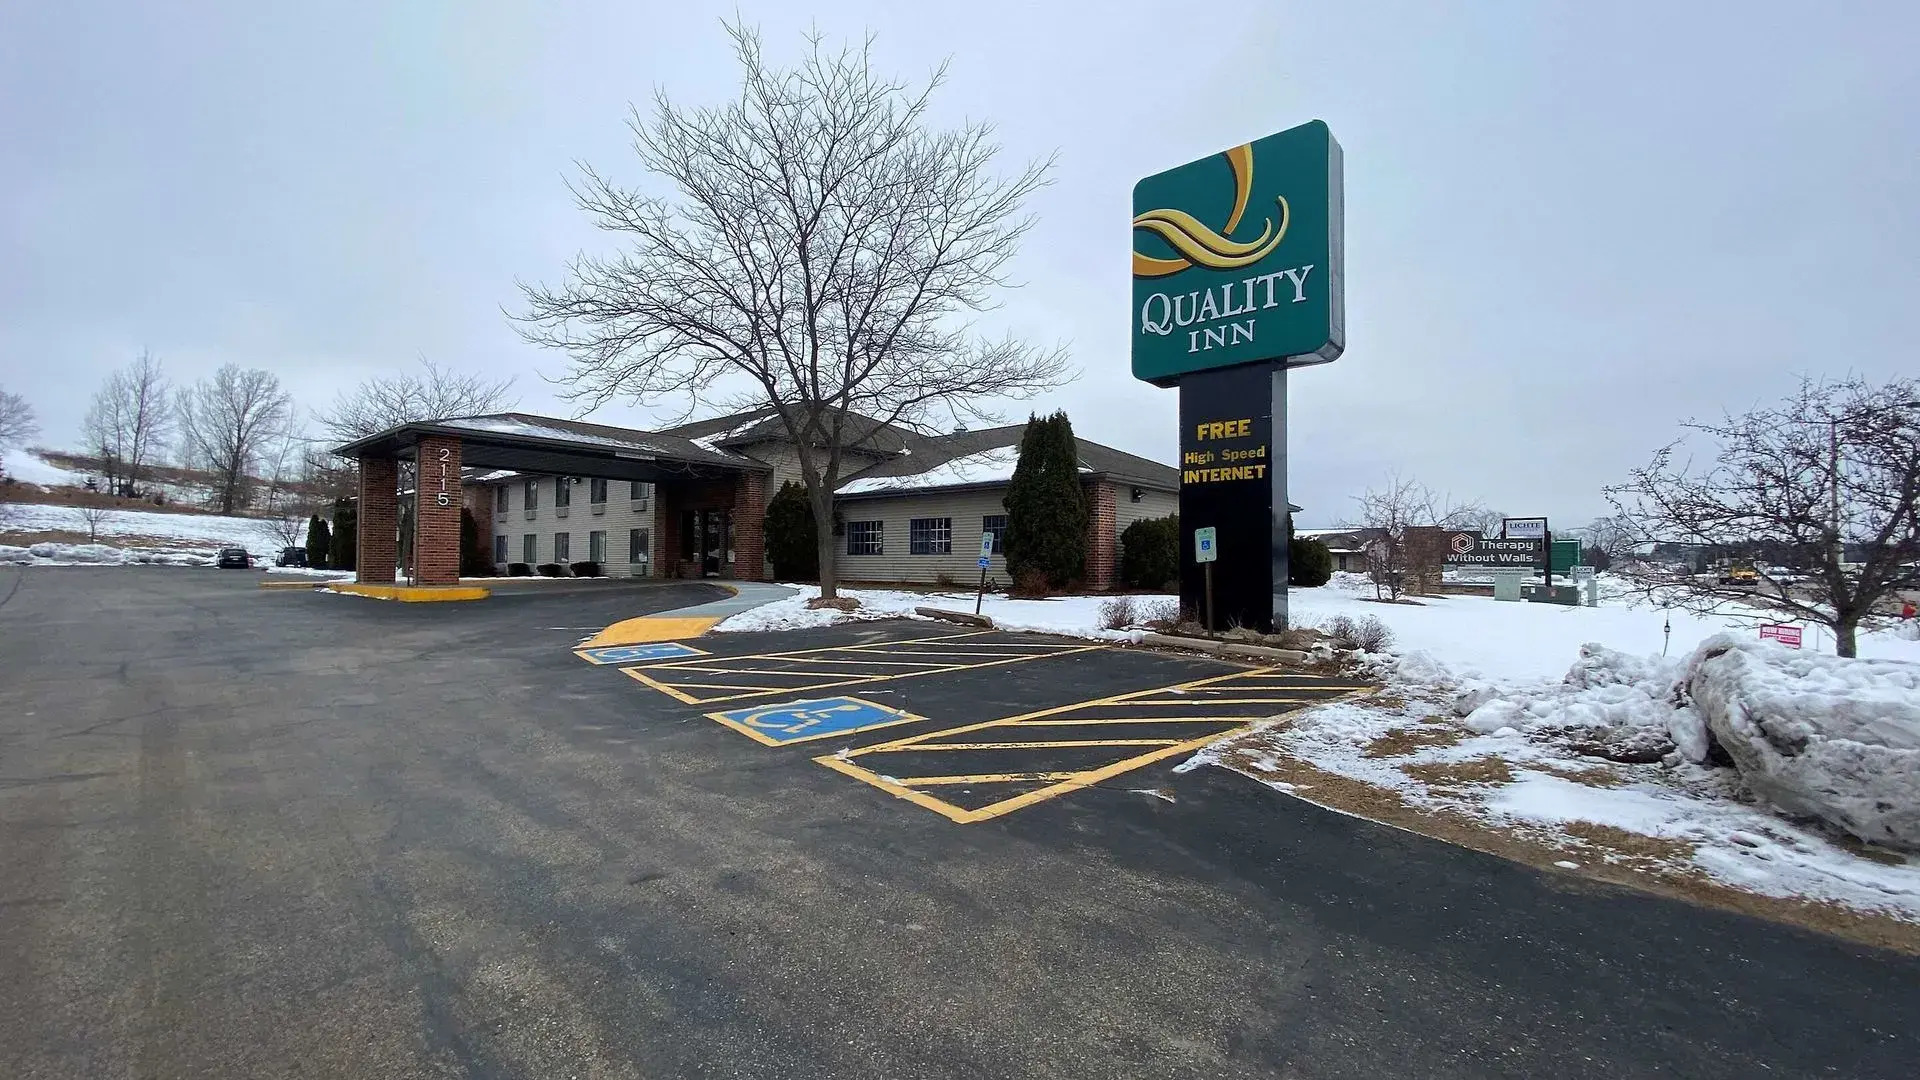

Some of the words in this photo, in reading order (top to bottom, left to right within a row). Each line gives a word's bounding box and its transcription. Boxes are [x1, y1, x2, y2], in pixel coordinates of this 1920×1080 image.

[1141, 265, 1315, 336] QUALITY
[1188, 320, 1256, 353] INN
[1197, 419, 1251, 441] FREE
[1184, 451, 1215, 465] High
[1221, 445, 1265, 461] Speed
[437, 448, 450, 506] 2115
[1183, 464, 1266, 484] INTERNET
[1479, 540, 1534, 551] Therapy
[1447, 553, 1495, 562] Without
[1499, 553, 1534, 562] Walls
